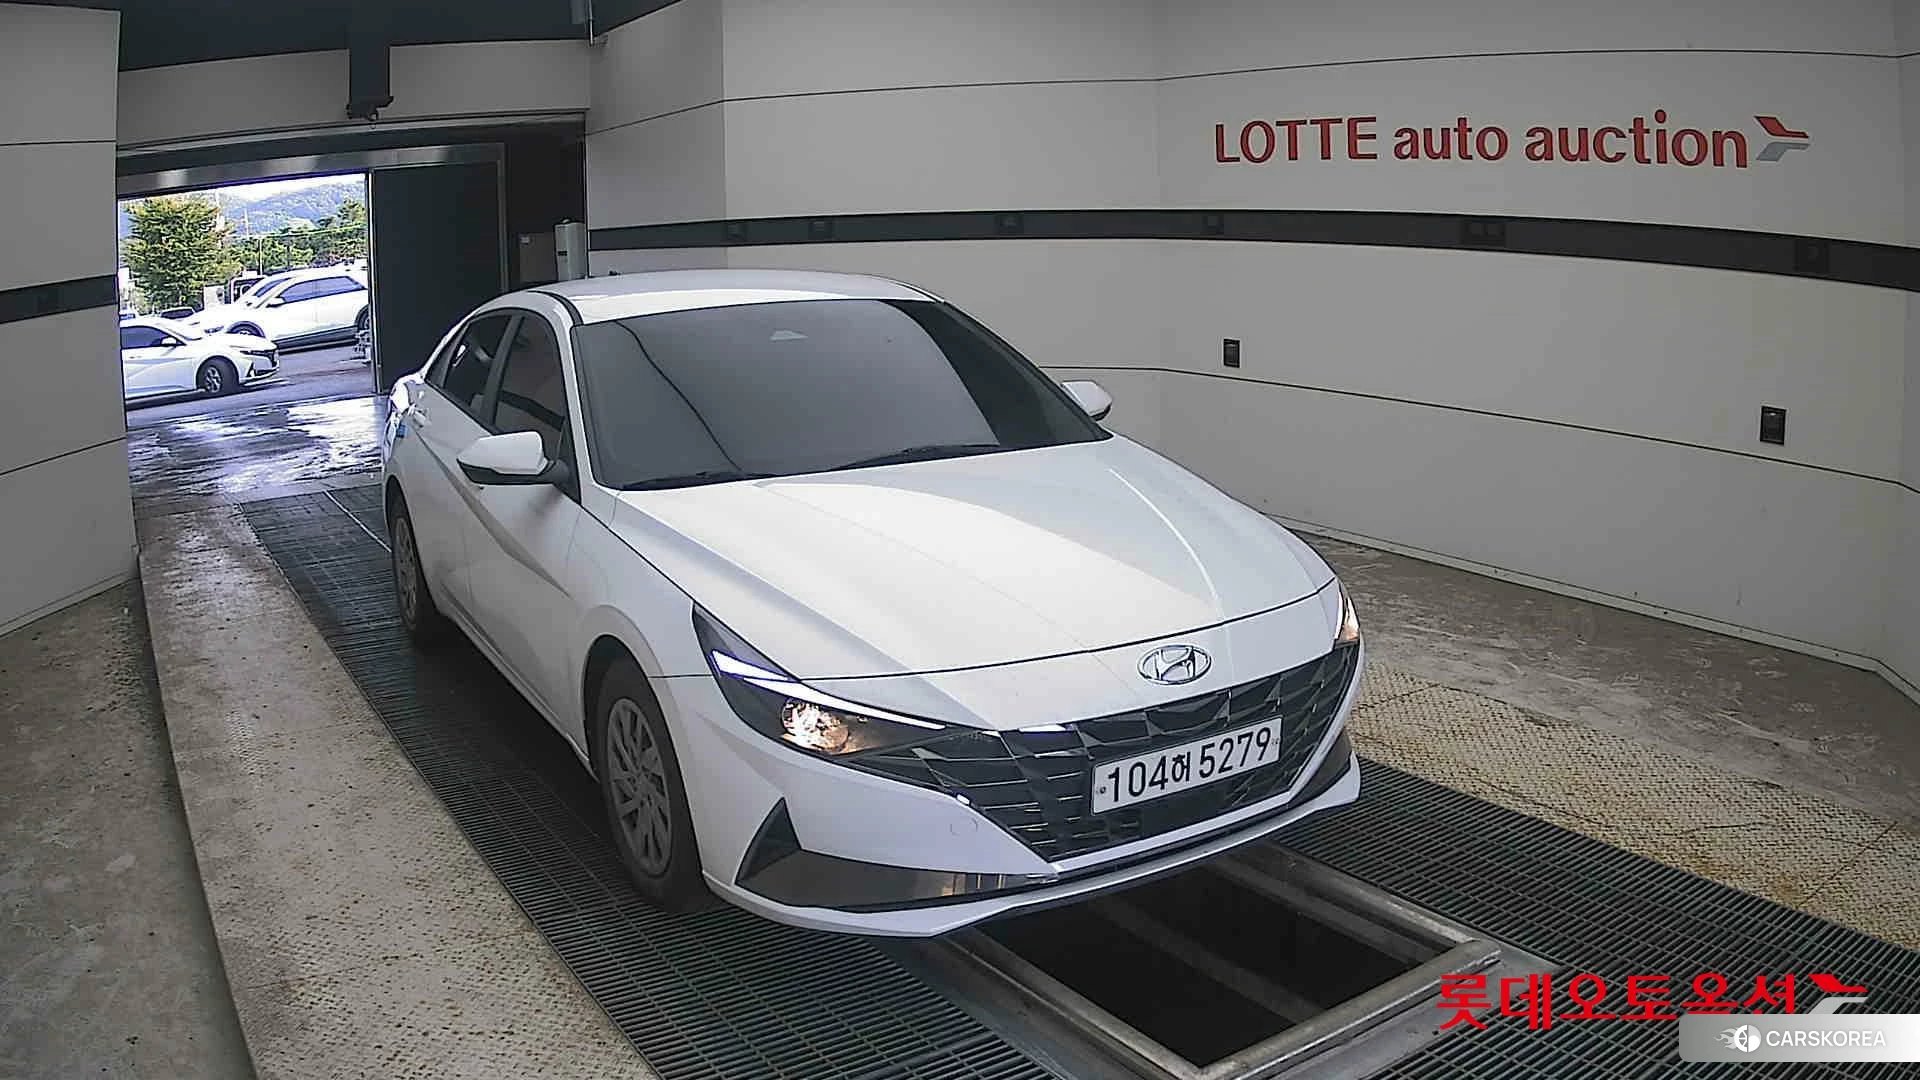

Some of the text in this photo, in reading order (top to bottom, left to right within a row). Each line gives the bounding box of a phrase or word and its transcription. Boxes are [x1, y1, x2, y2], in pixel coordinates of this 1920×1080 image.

[1215, 109, 1748, 168] LOTTE auto auction
[1108, 727, 1272, 801] 104허 5279
